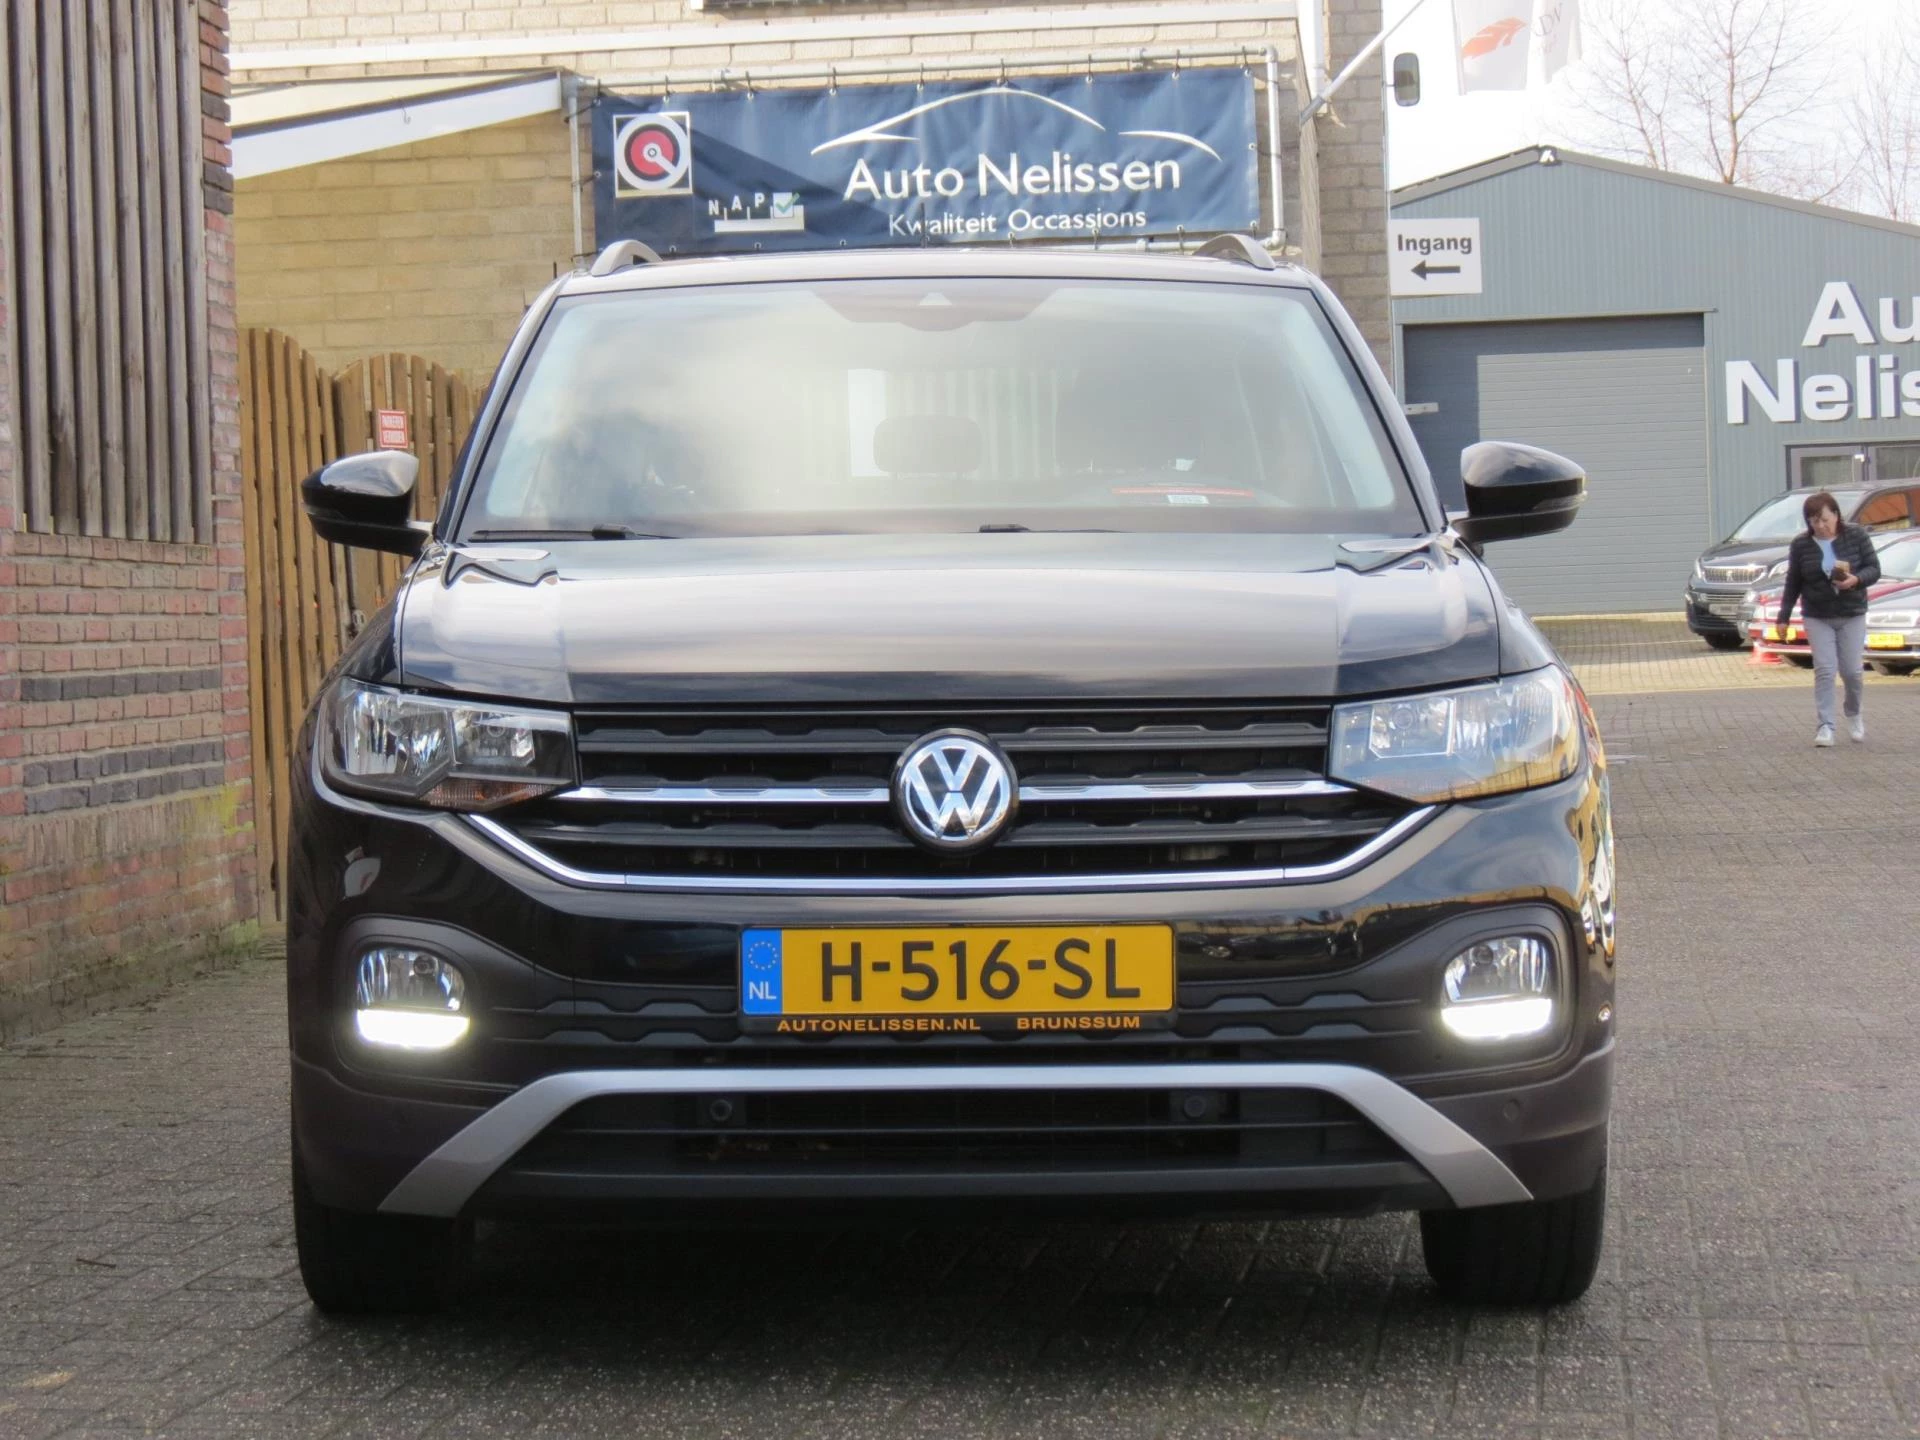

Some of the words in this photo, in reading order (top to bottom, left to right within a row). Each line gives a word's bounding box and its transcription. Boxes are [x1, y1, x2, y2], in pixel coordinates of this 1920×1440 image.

[844, 158, 964, 200] Auto
[978, 151, 1181, 196] Nelissen
[889, 212, 997, 237] Kwaliteit
[1008, 207, 1147, 231] Occassions
[1397, 234, 1472, 256] Ingang
[821, 938, 1140, 1002] H-516-SL
[749, 981, 777, 1000] NL
[777, 1019, 981, 1032] AUTONELISSEN.NL
[1017, 1016, 1140, 1030] BRUNSSUM
